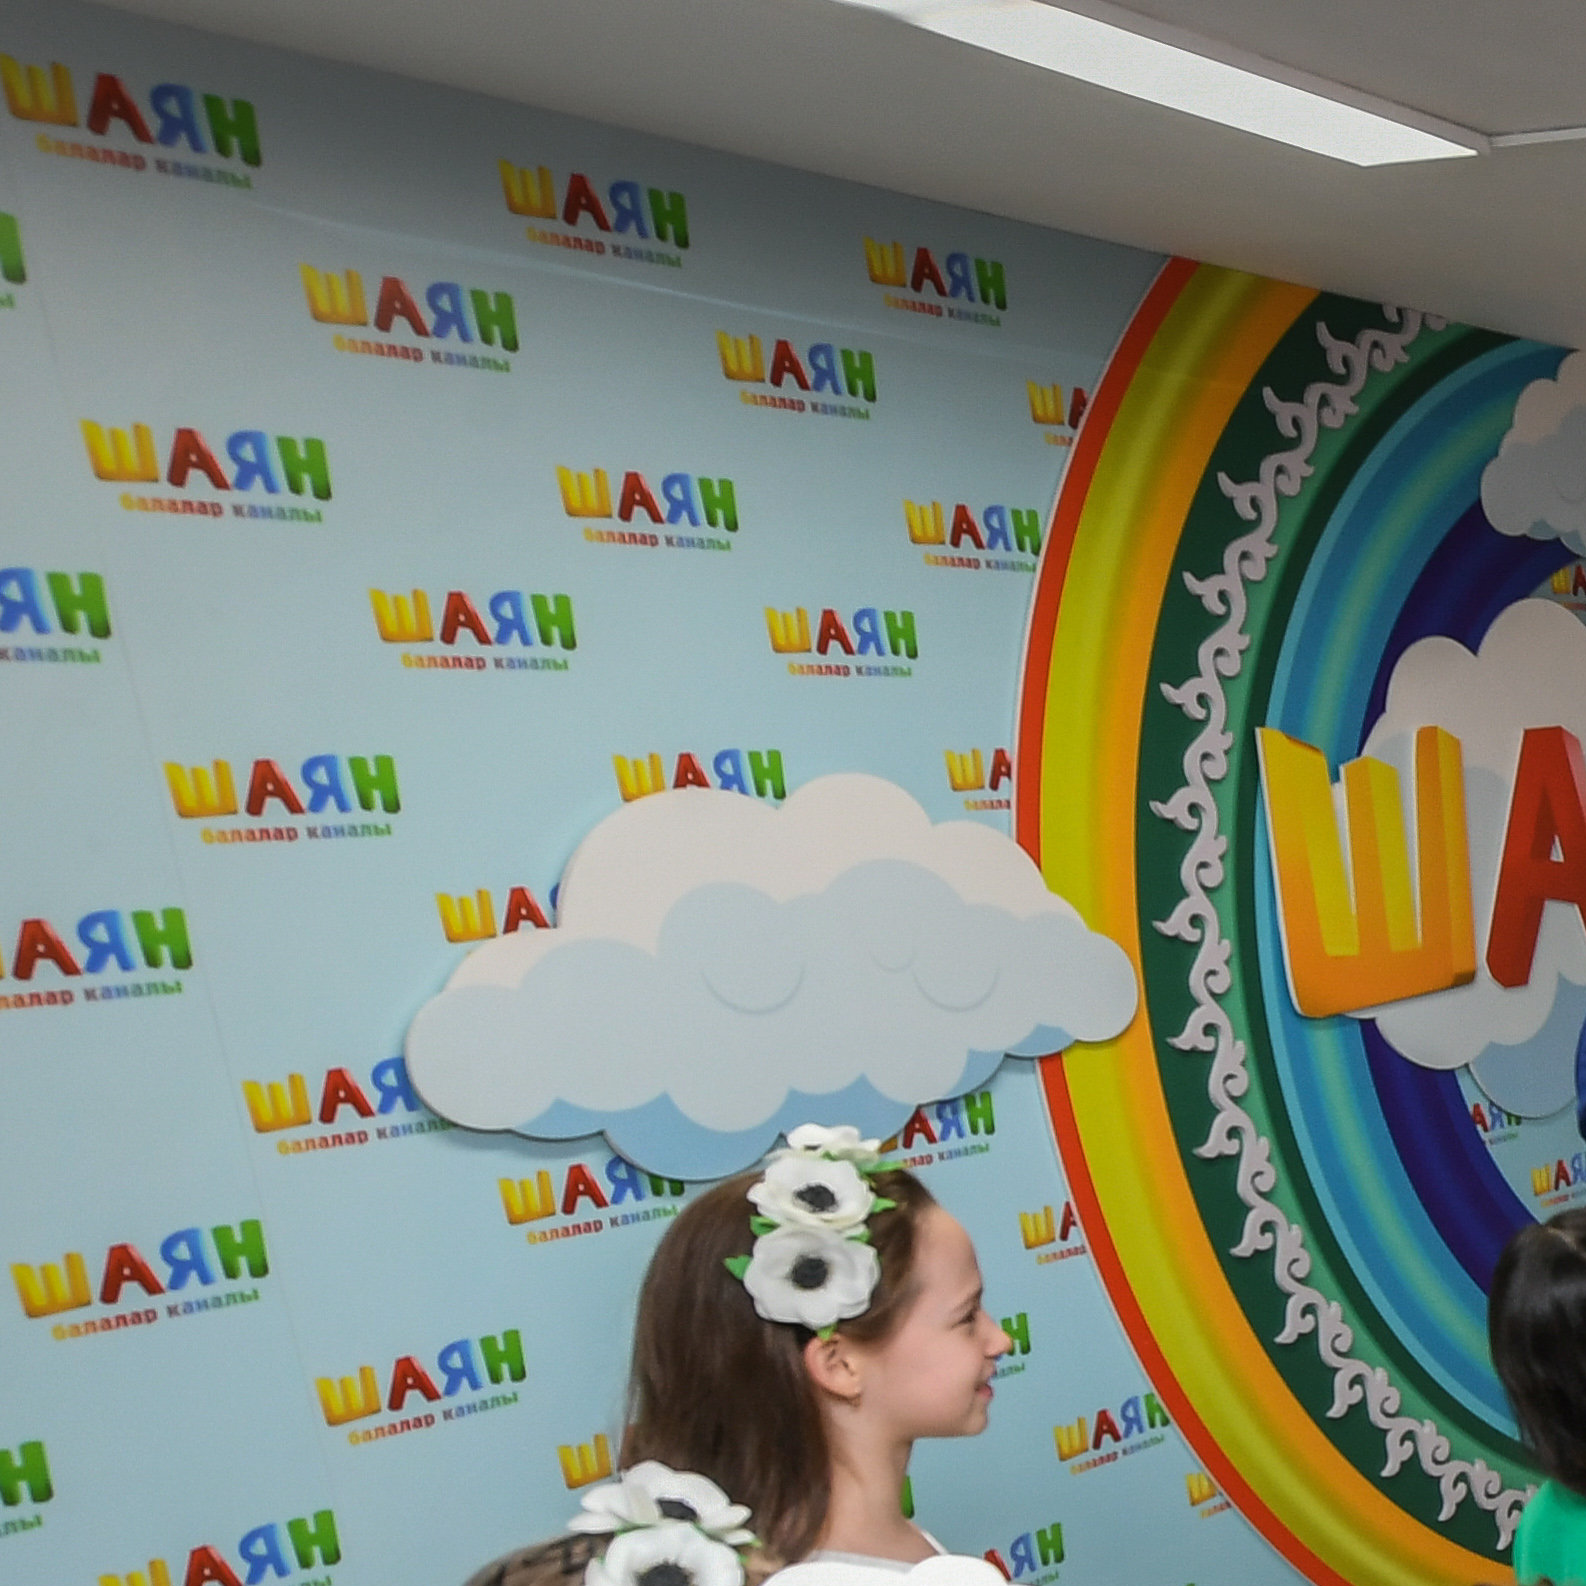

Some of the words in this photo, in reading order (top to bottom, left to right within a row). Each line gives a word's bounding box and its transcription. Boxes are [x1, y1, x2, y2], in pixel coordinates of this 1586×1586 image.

[0, 53, 262, 167] ШАЯН
[500, 158, 690, 249] ШАЯН
[300, 263, 519, 353] ШАЯН
[863, 235, 1007, 311] ШАЯН
[716, 329, 877, 403] ШАЯН
[80, 418, 332, 501] ШАЯН
[556, 464, 739, 532] ШАЯН
[903, 499, 1041, 556] ШАЯН
[0, 567, 111, 639] ЯН
[368, 588, 577, 651] ШАЯН
[764, 606, 919, 660] ШАЯН
[163, 753, 401, 819] ШАЯН
[611, 748, 787, 802] ШАЯН
[944, 748, 1011, 793] ША
[0, 907, 193, 981] АЯН
[434, 884, 560, 944] ША
[241, 1056, 421, 1135] ШАЯ
[878, 1091, 995, 1155] АЯН
[1530, 1152, 1586, 1196] ШАЯ
[1018, 1201, 1078, 1250] ША
[11, 1218, 269, 1318] ШАЯН
[315, 1329, 526, 1427] ШАЯН
